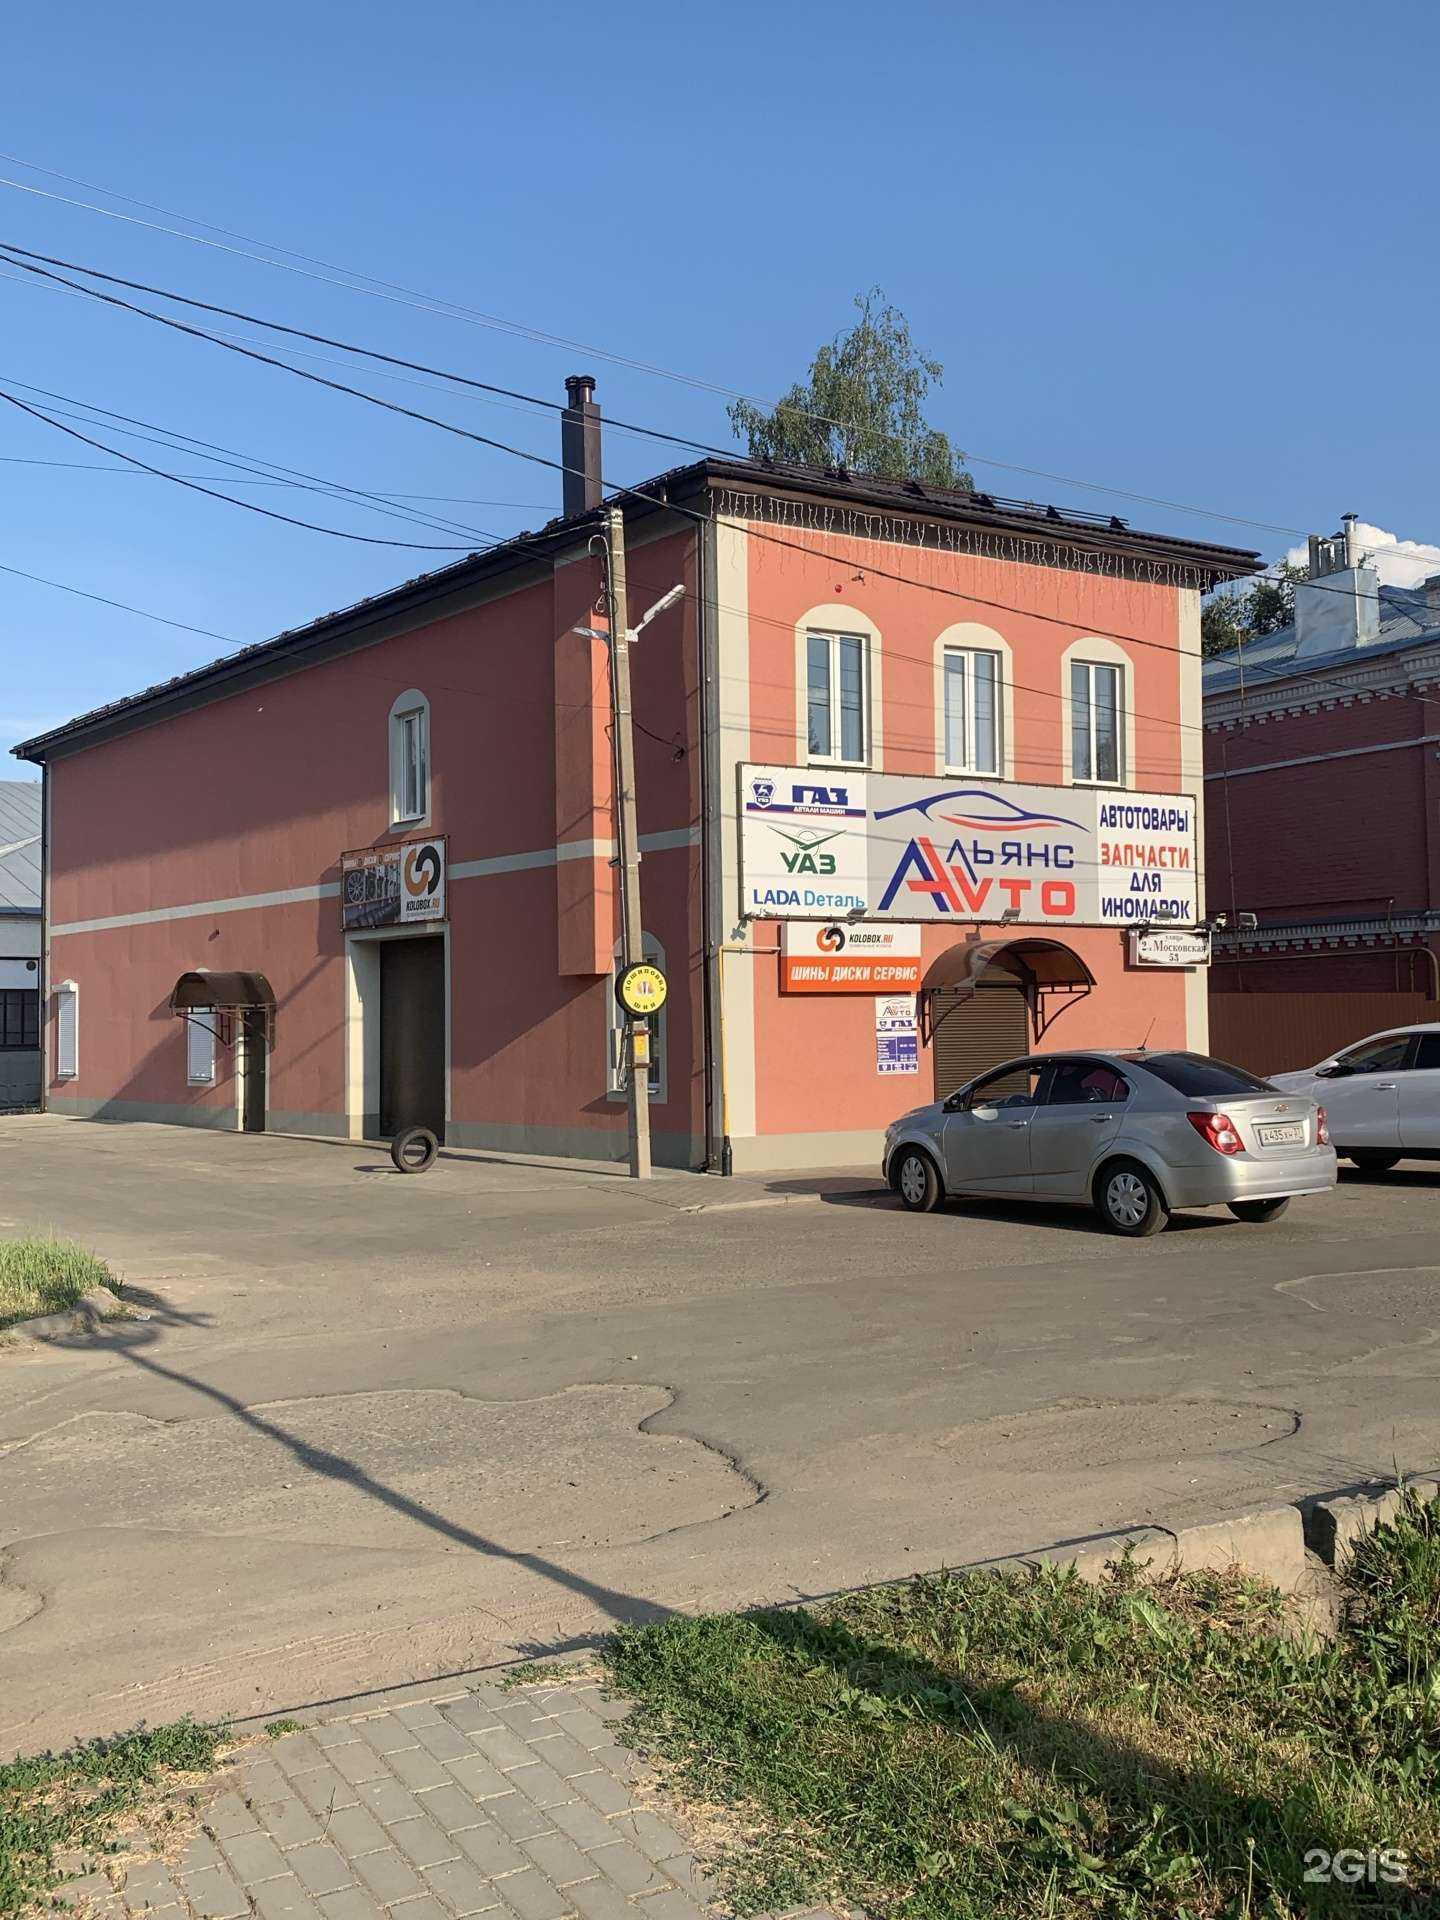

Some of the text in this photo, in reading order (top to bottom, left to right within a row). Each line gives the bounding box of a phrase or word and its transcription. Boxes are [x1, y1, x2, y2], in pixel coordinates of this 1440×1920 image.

[791, 784, 848, 806] ГАЗ
[1100, 804, 1188, 832] АВТОТОВАРЫ
[780, 852, 836, 875] УАЗ
[1101, 842, 1189, 869] ЗАПЧАСТИ
[1130, 872, 1161, 892] ДЛЯ
[753, 888, 800, 906] LADA
[849, 934, 894, 944] KOLOBOX.RU
[1153, 940, 1207, 953] Московская
[791, 966, 918, 982] ШИНЫ ДИСКИ СЕРВИС
